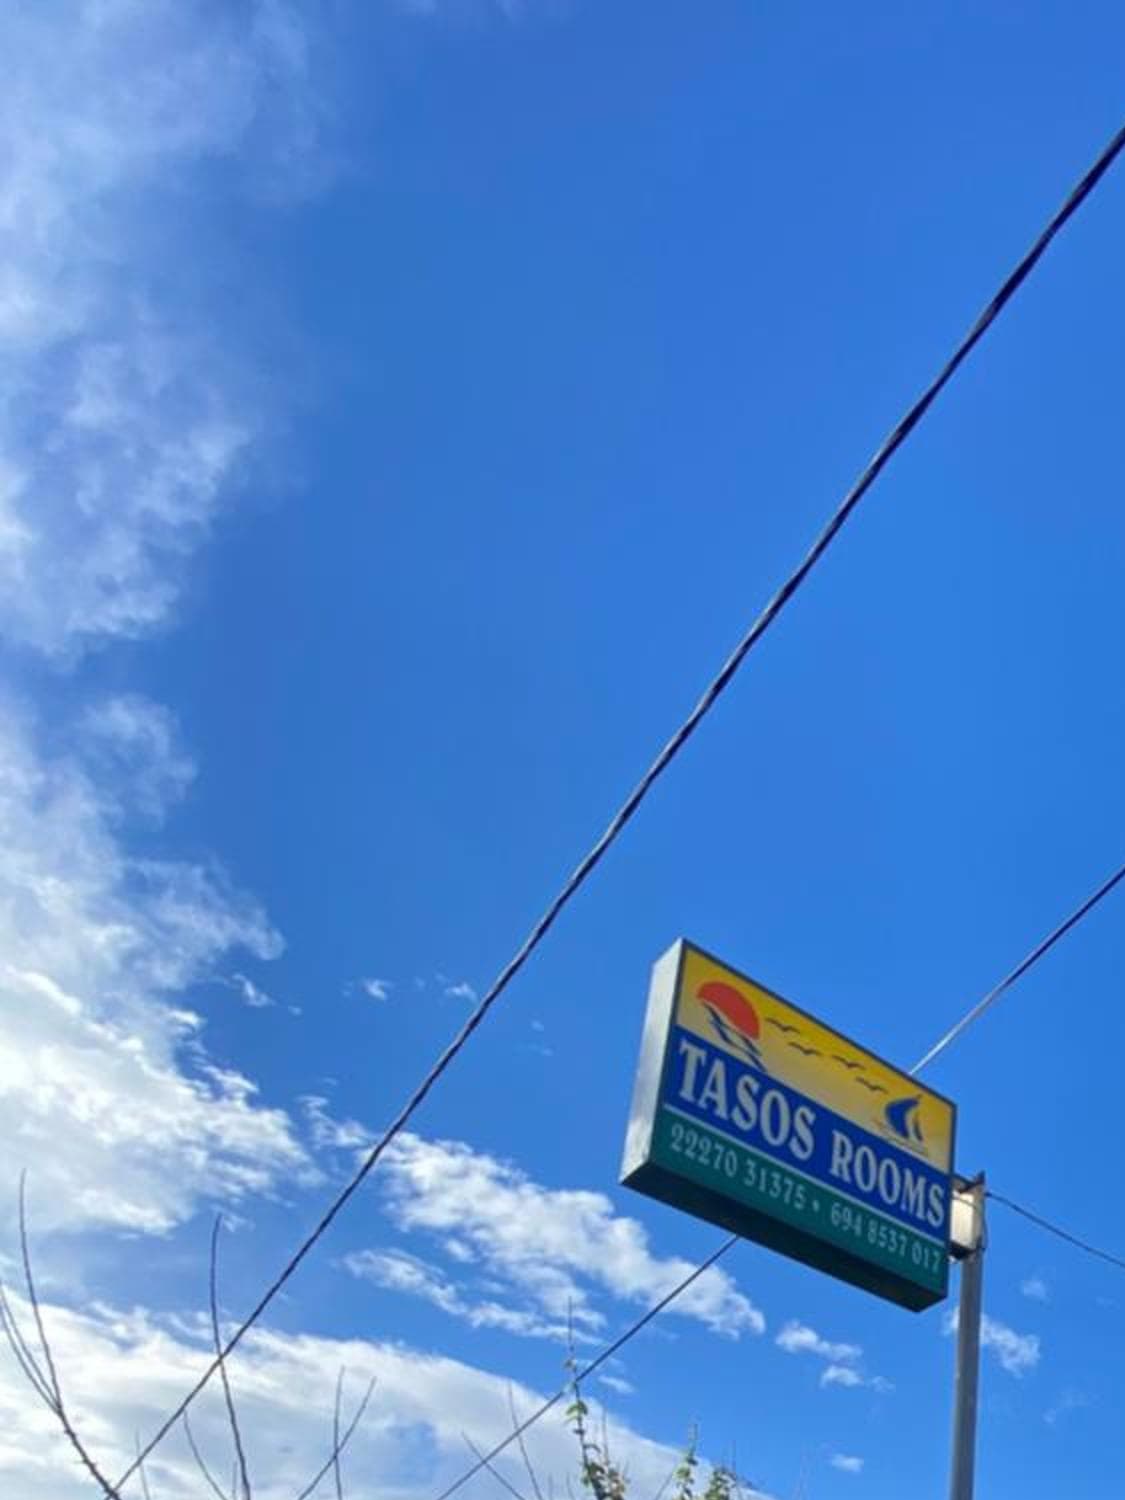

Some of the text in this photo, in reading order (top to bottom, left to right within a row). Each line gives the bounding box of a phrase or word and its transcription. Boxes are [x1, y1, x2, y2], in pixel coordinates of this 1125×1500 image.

[670, 1123, 941, 1274] 22270 31375 694 8537 017
[679, 1038, 945, 1228] TASOS ROOMS
